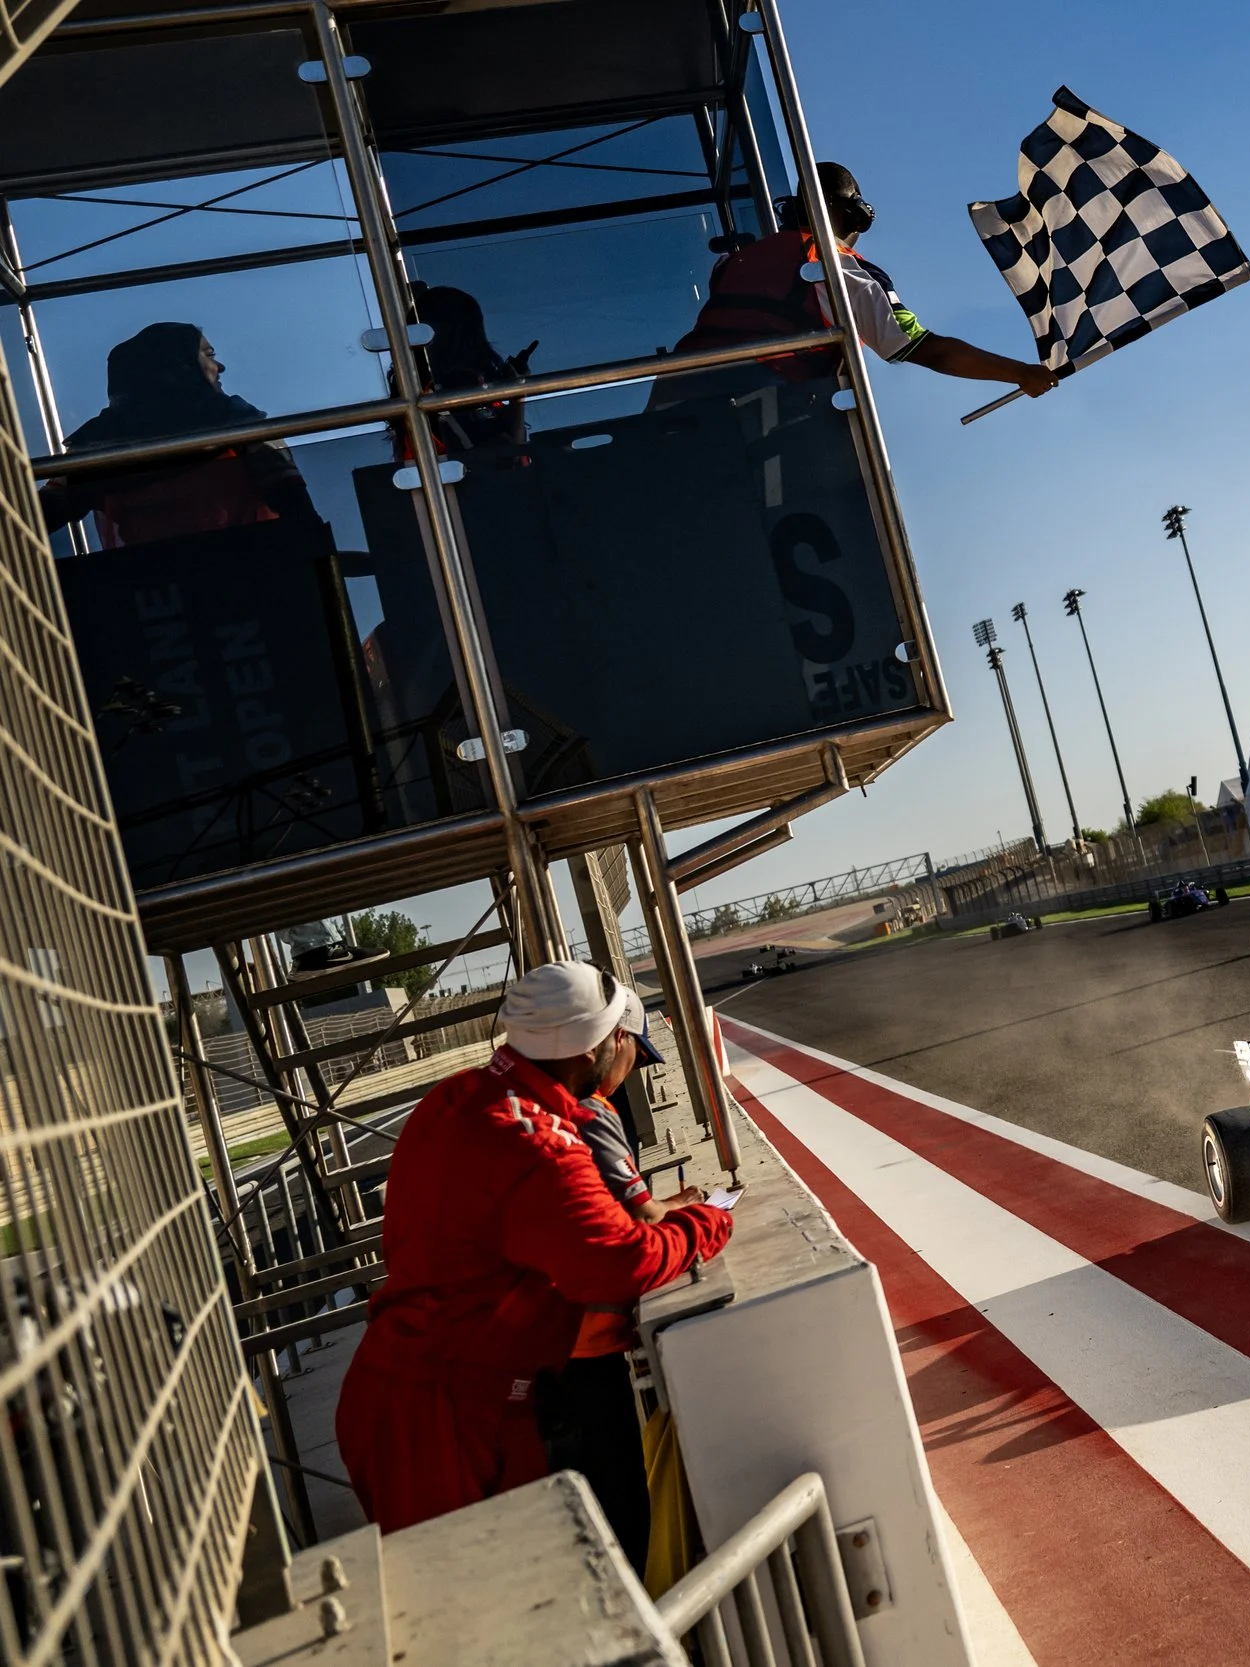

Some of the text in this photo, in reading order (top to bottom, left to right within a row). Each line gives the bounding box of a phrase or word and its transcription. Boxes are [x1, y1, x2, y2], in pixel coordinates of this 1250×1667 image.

[133, 583, 238, 836] PT LANE
[213, 619, 293, 770] OPEN
